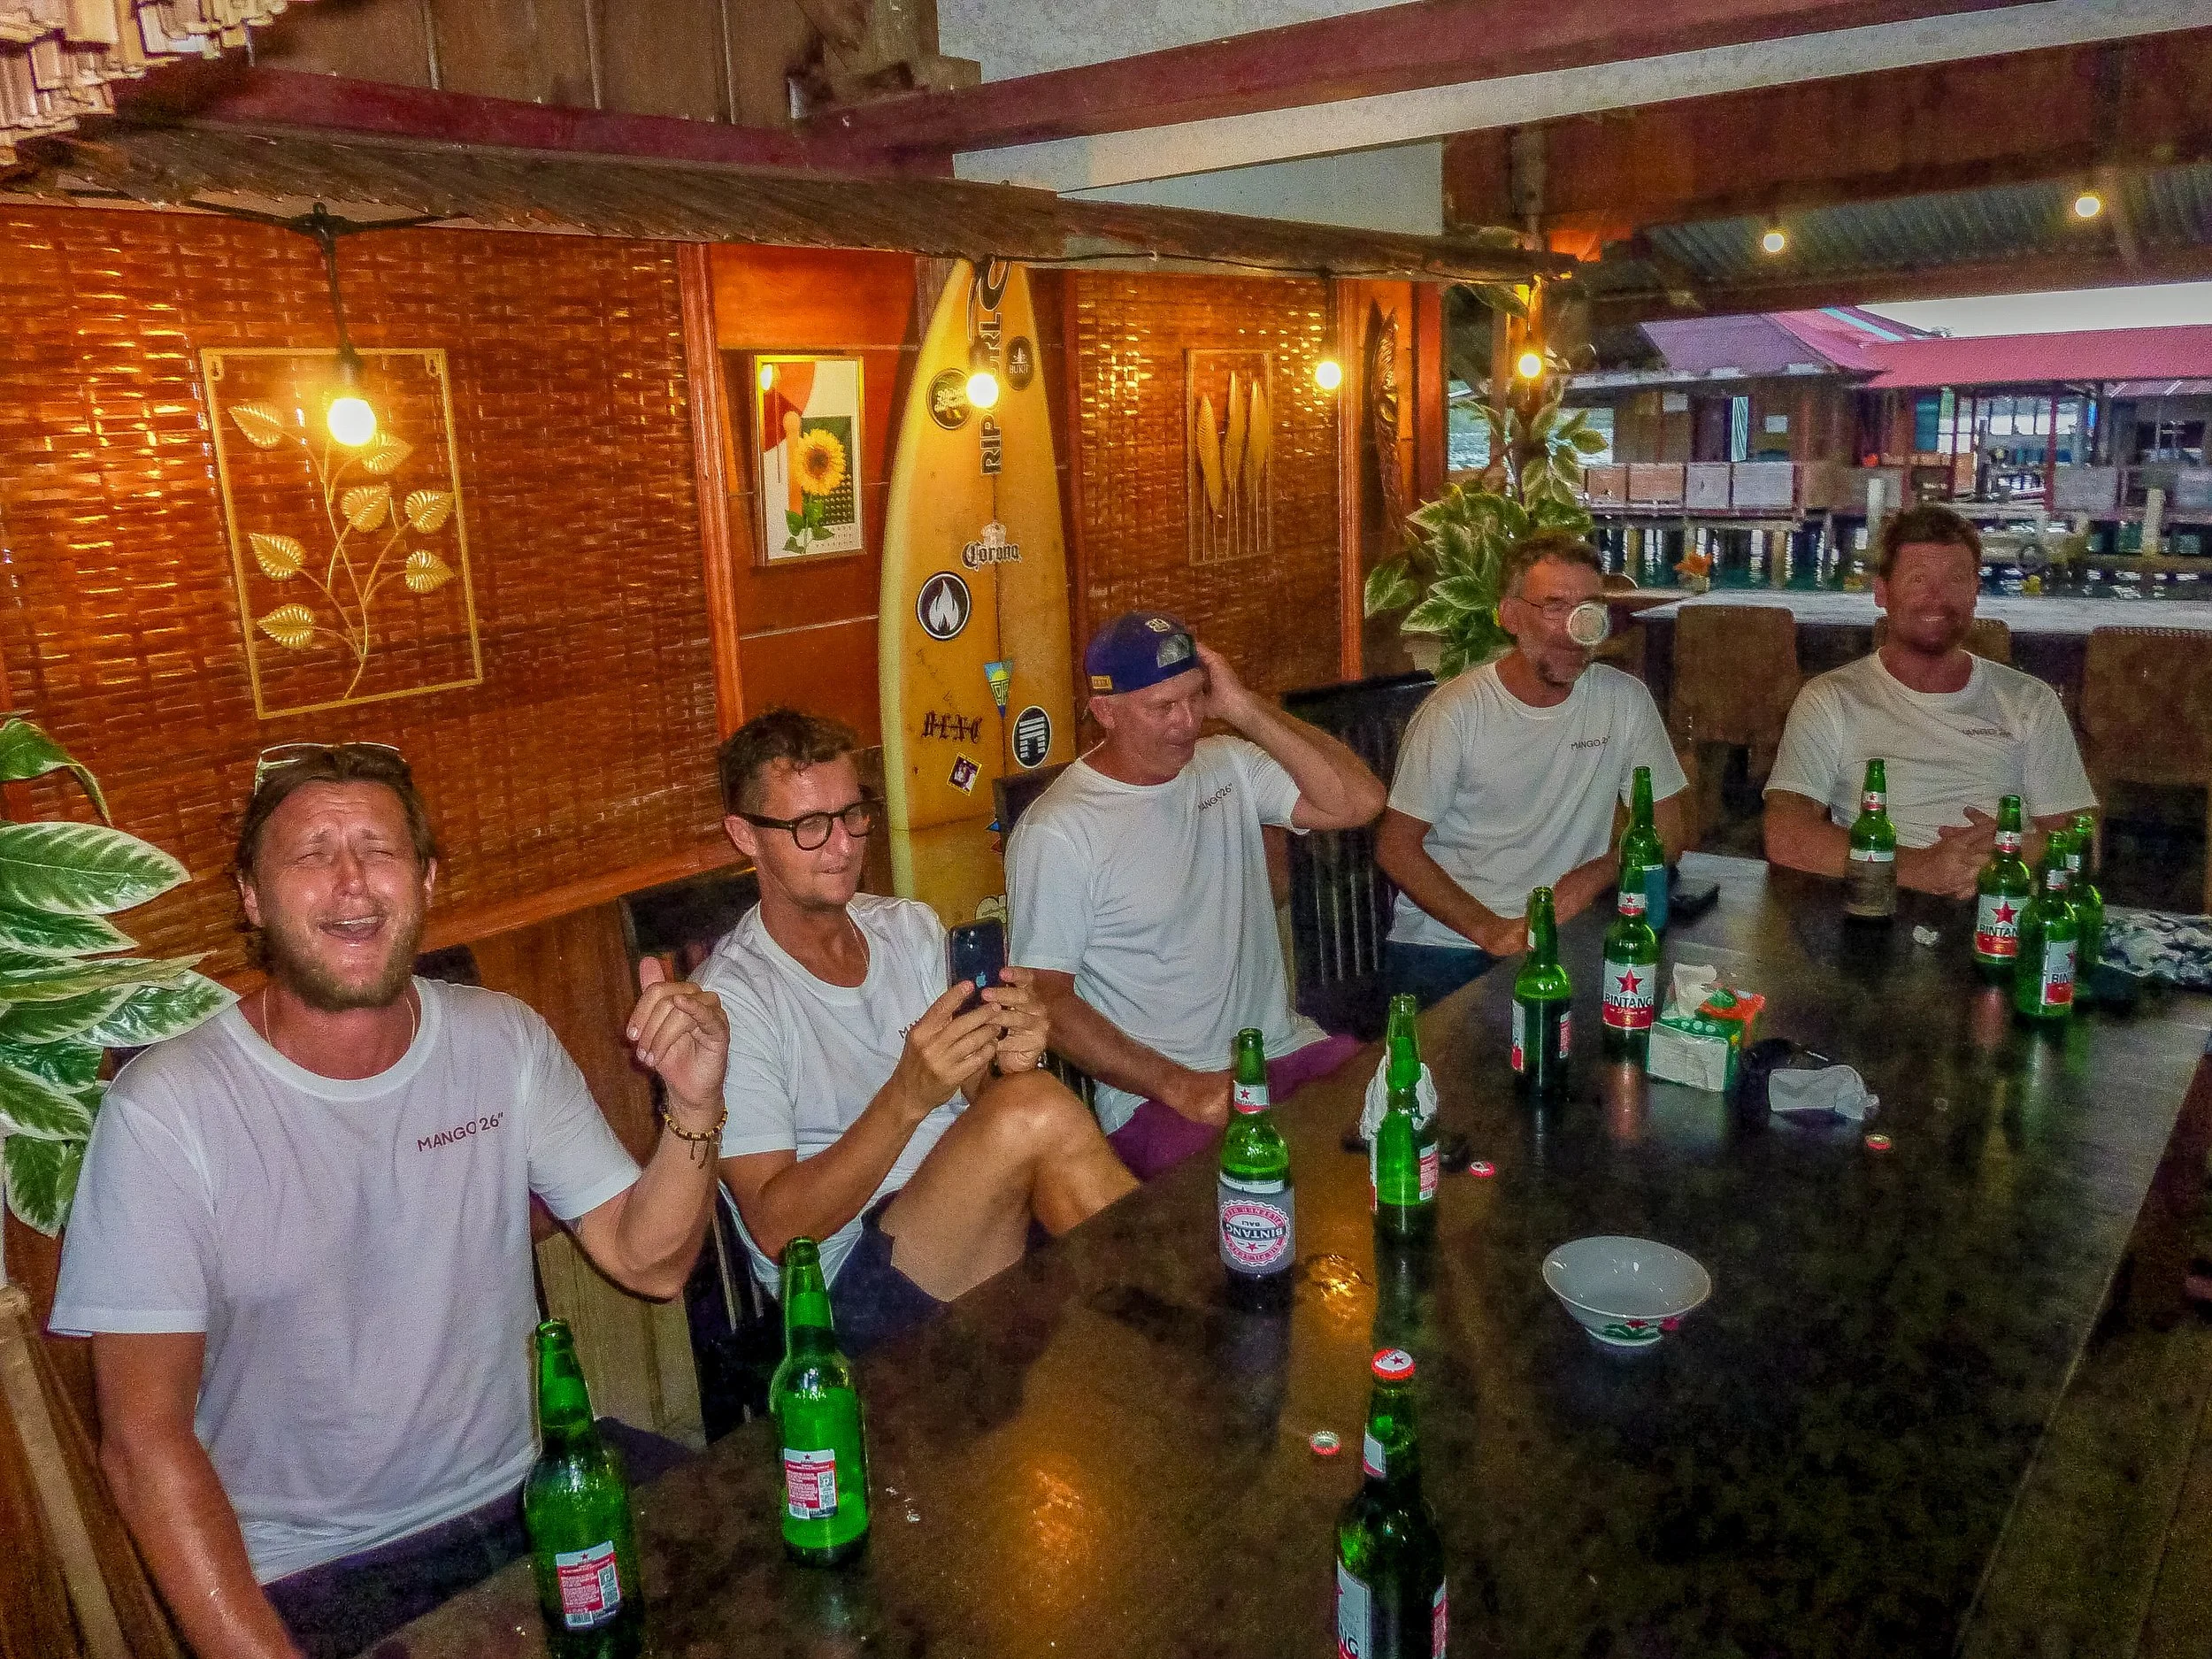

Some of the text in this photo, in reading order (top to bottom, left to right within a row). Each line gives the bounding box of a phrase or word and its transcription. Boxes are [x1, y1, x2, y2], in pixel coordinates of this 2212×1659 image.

[979, 414, 1002, 475] RIP
[962, 541, 1021, 571] Corona
[1979, 924, 2017, 938] BINTAN
[1604, 993, 1653, 1009] BINTANG
[417, 1120, 477, 1152] MANGO
[1226, 1223, 1283, 1239] BINTANG
